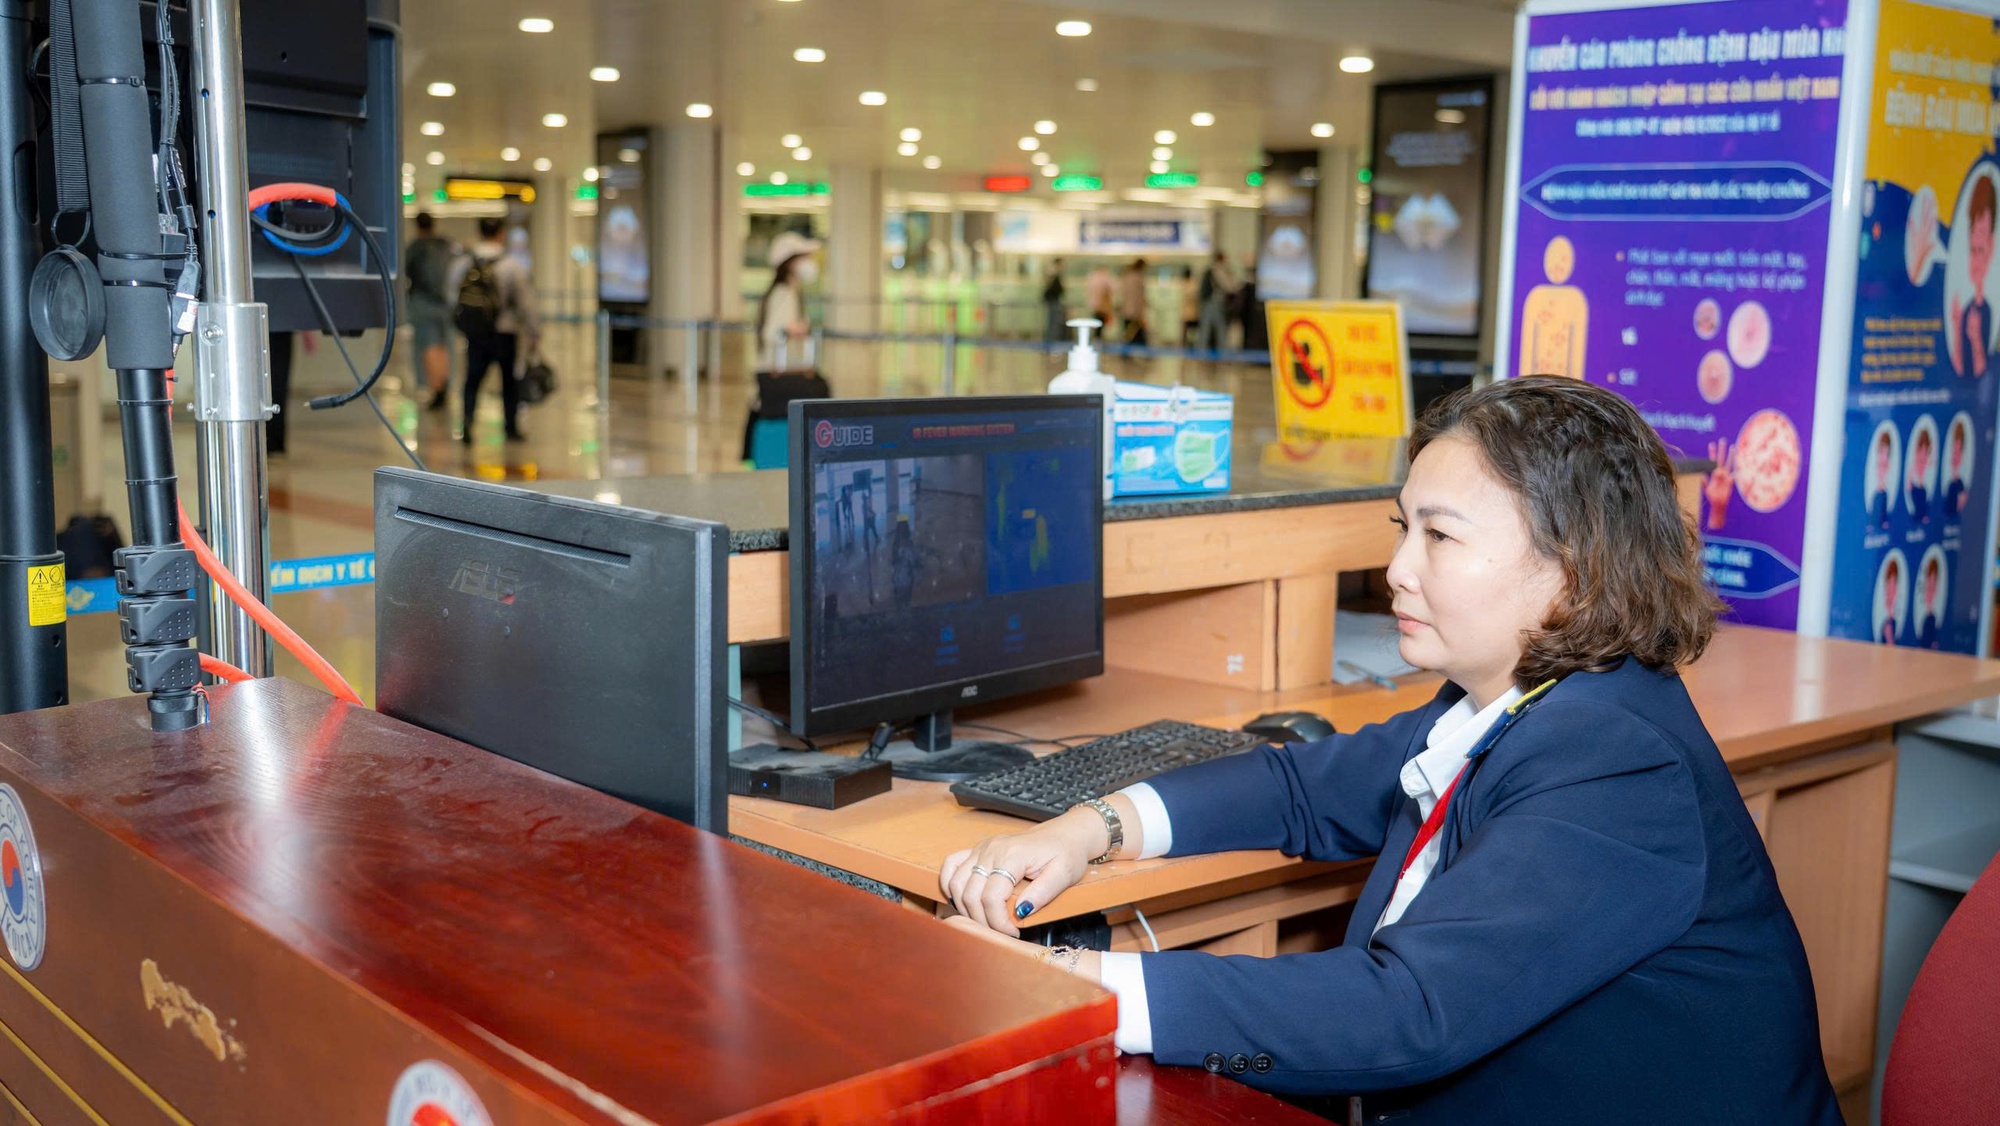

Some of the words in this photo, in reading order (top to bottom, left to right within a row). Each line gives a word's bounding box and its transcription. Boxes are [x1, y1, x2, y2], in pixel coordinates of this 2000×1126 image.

[1707, 29, 1747, 67] BỆNH
[815, 420, 874, 448] GUIDE
[923, 425, 947, 438] FEVER
[986, 421, 1015, 435] SYSTEM
[298, 565, 333, 587] DỊCH
[336, 562, 346, 581] Y
[350, 557, 365, 580] TẾ
[447, 560, 520, 605] ASUS
[960, 685, 978, 698] AOC
